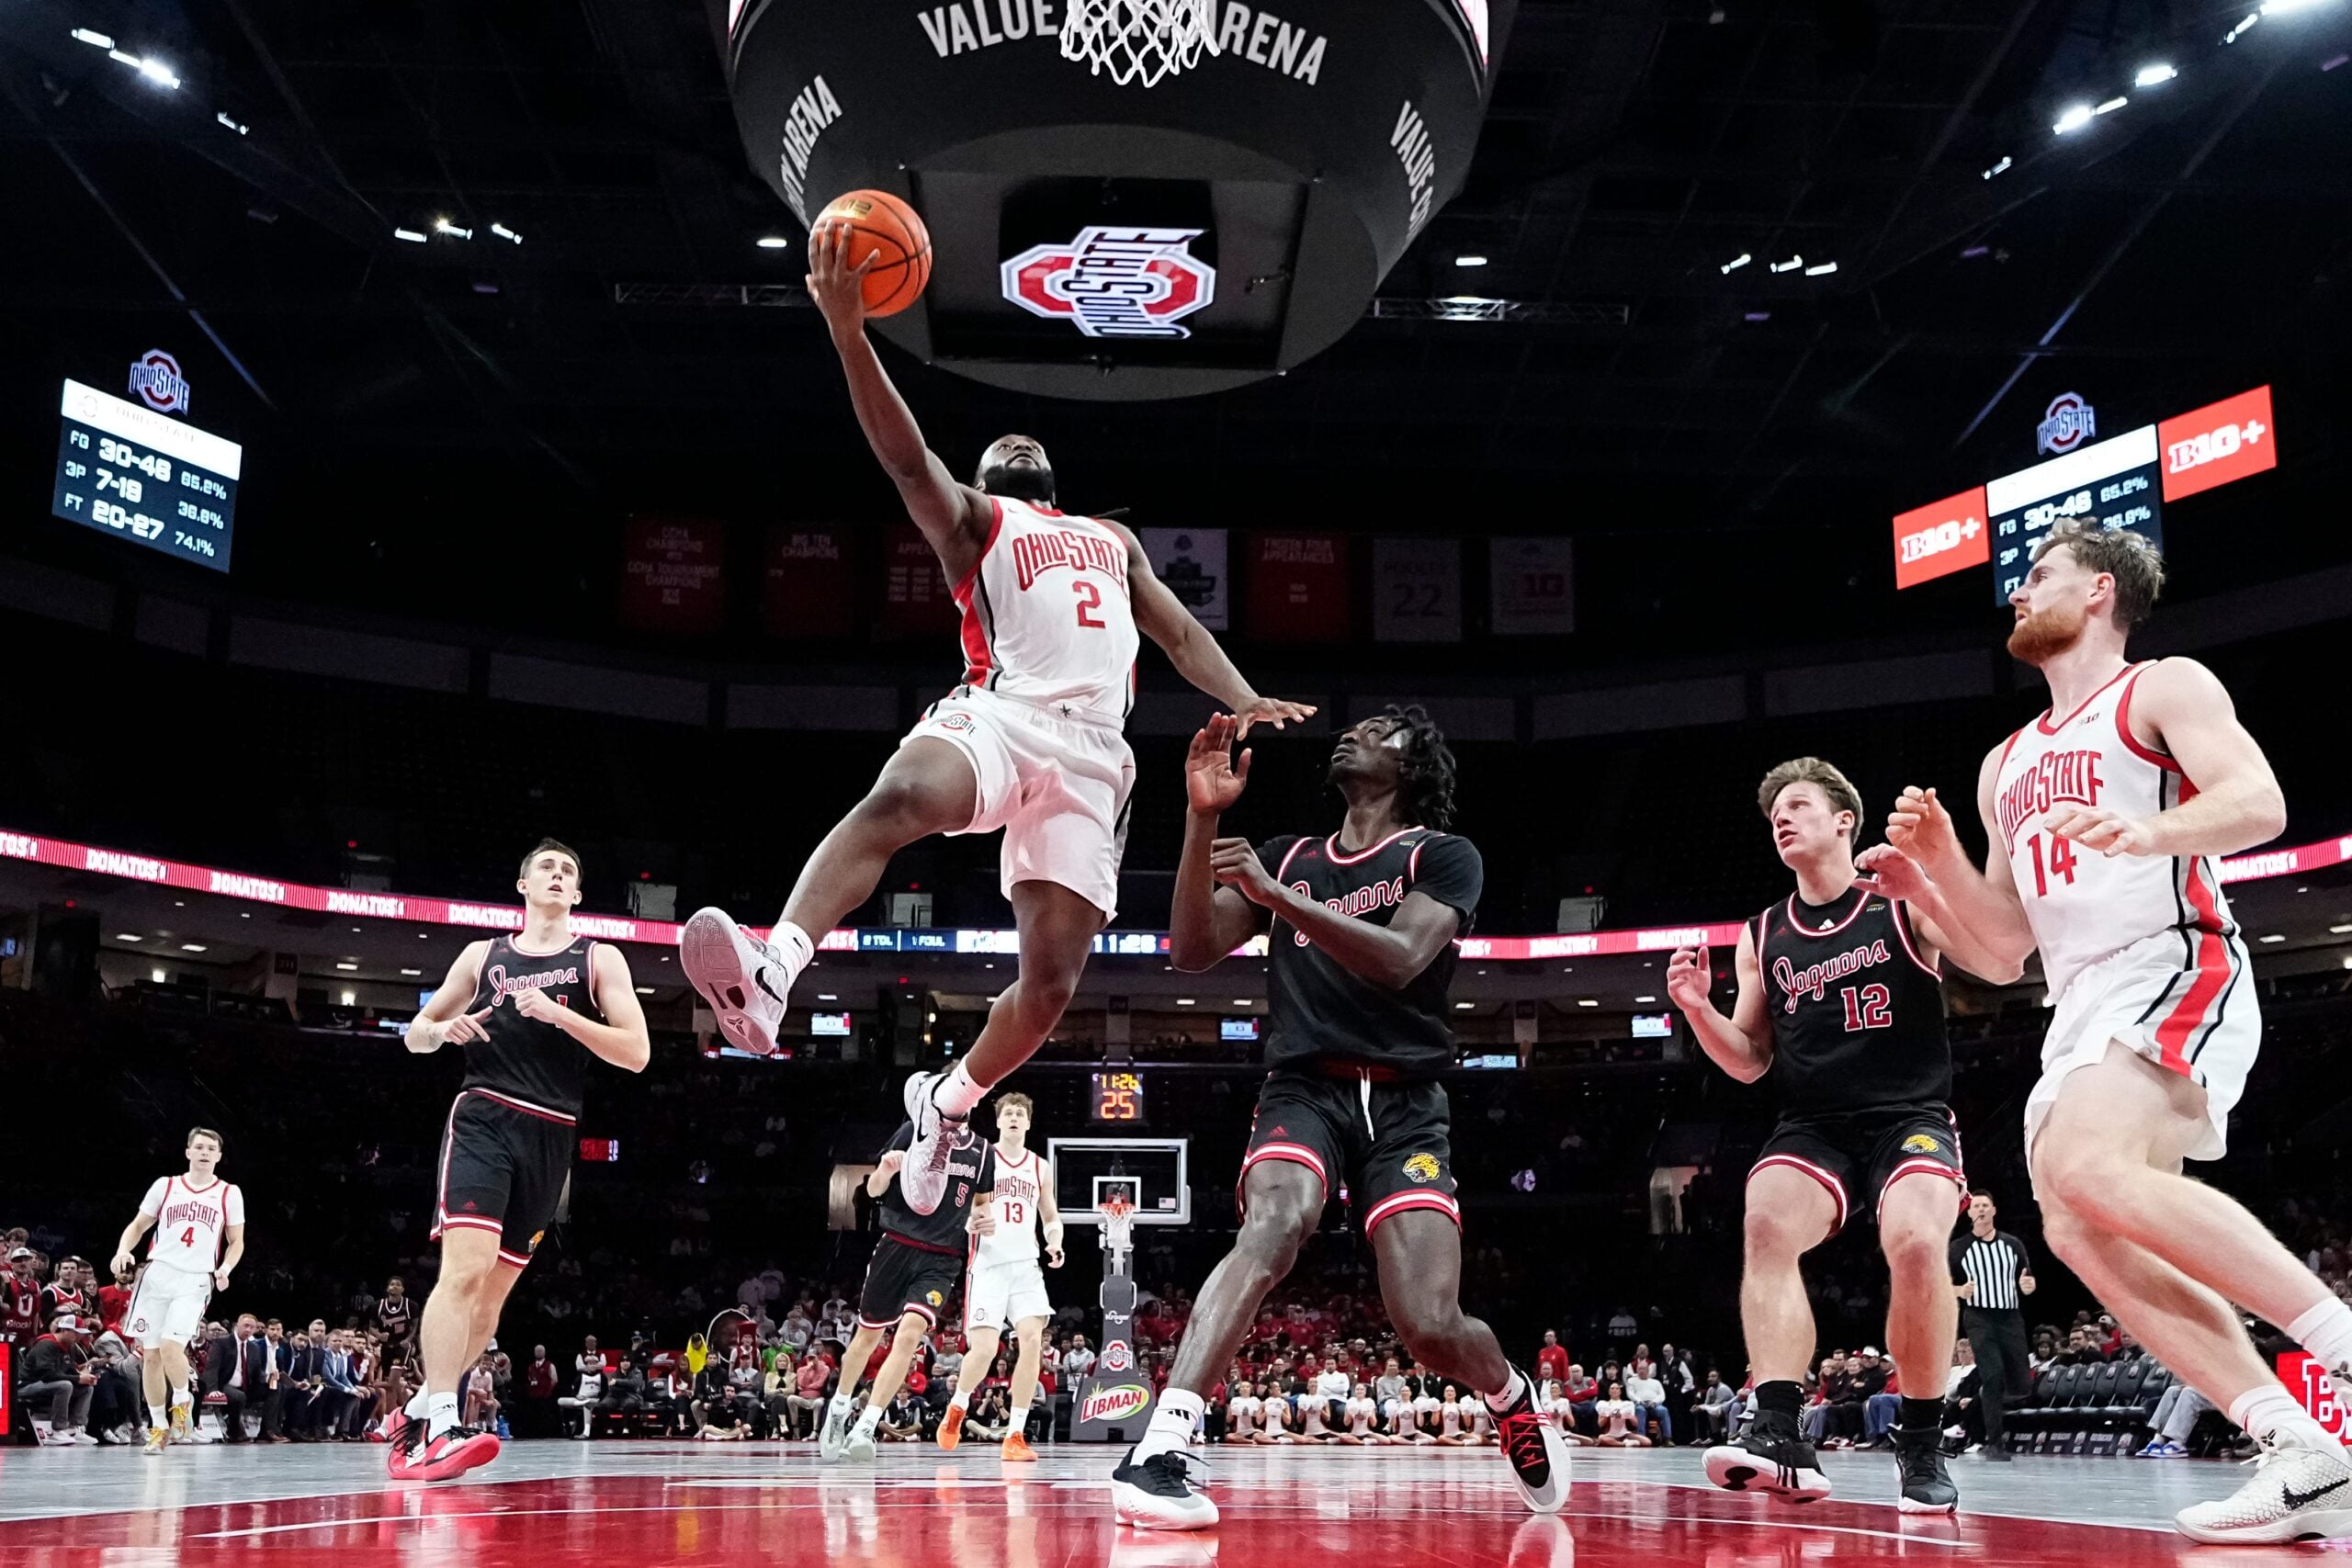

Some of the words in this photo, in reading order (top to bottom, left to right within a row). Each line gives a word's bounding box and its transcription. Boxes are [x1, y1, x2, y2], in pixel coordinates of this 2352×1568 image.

[917, 0, 1058, 58] VALUE
[1194, 0, 1329, 86] RENA
[783, 74, 843, 180] ARENA
[1390, 100, 1434, 204] VALUE
[65, 460, 86, 479] 3P
[64, 492, 84, 512] FT
[92, 499, 165, 540] 20-27
[175, 531, 215, 558] 74.1%
[1071, 580, 1106, 629] 2
[1392, 581, 1444, 618] 22
[2027, 832, 2077, 898] 14
[1773, 939, 1891, 1014] Jaguars
[1840, 983, 1893, 1032] 12
[1100, 1073, 1139, 1090] 11:26
[1101, 1090, 1135, 1119] 25
[956, 1182, 969, 1207] 5
[1003, 1201, 1023, 1224] 13
[180, 1226, 194, 1248] 4
[1082, 1390, 1143, 1421] LIBMAN
